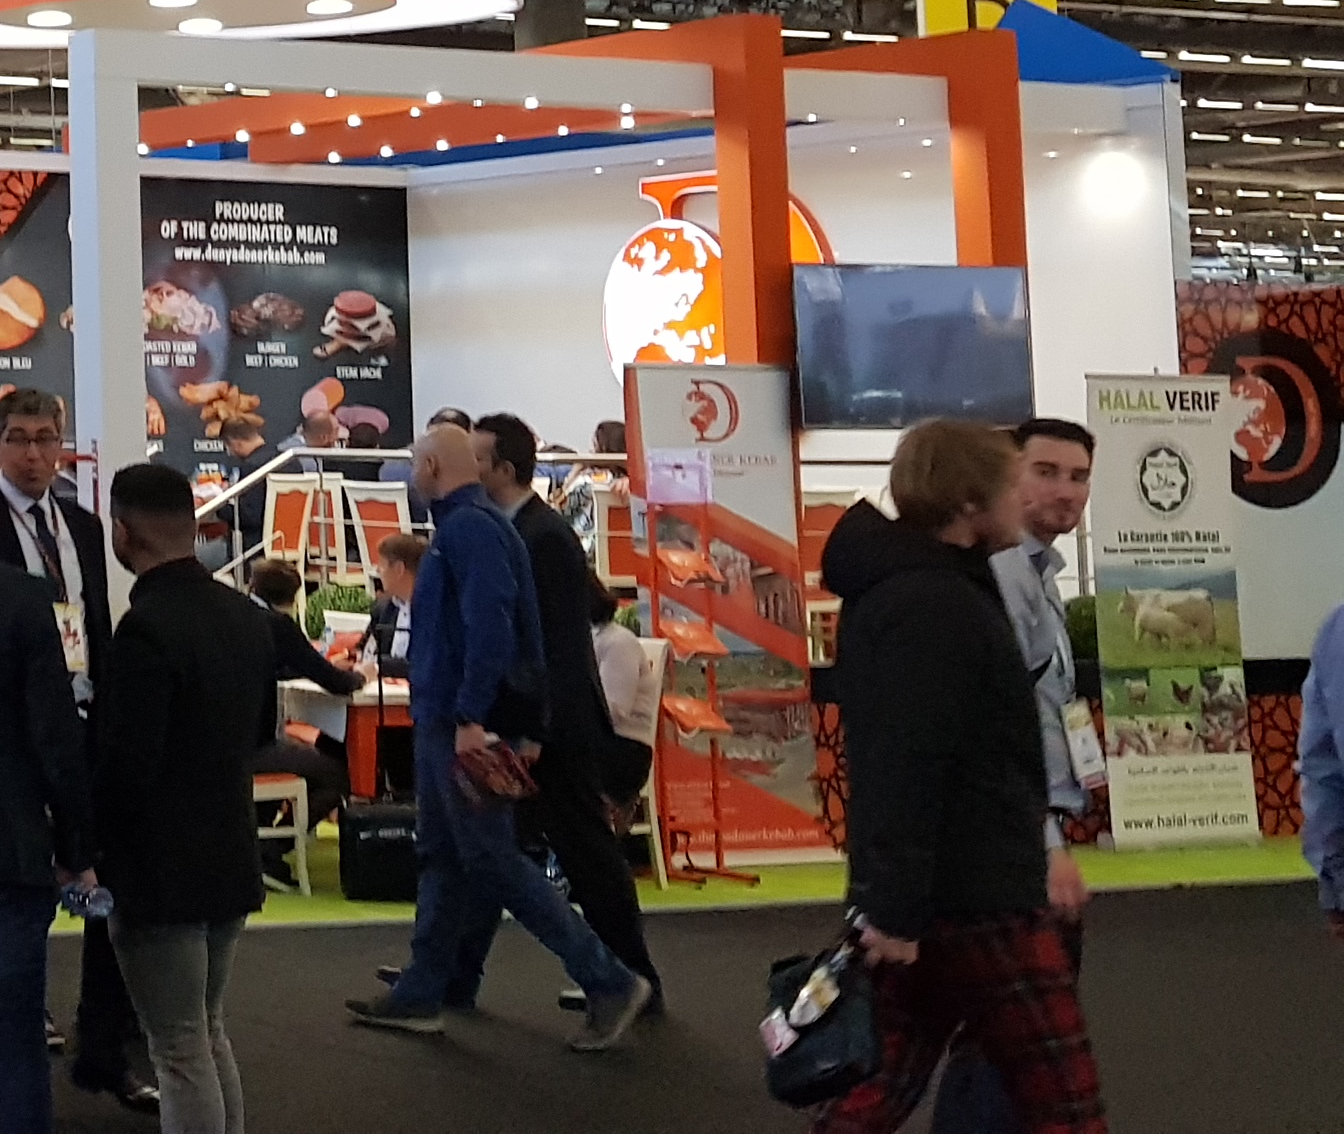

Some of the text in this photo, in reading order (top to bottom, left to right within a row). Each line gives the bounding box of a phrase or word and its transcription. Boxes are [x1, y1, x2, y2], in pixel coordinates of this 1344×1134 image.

[215, 200, 285, 222] PRODUCER
[160, 219, 339, 246] OF THE COMBINATED MEATS
[174, 243, 326, 266] www.dunyadonerkebab.com
[1097, 388, 1221, 413] HALAL VERIF
[1123, 810, 1249, 830] www.halal-verif.com
